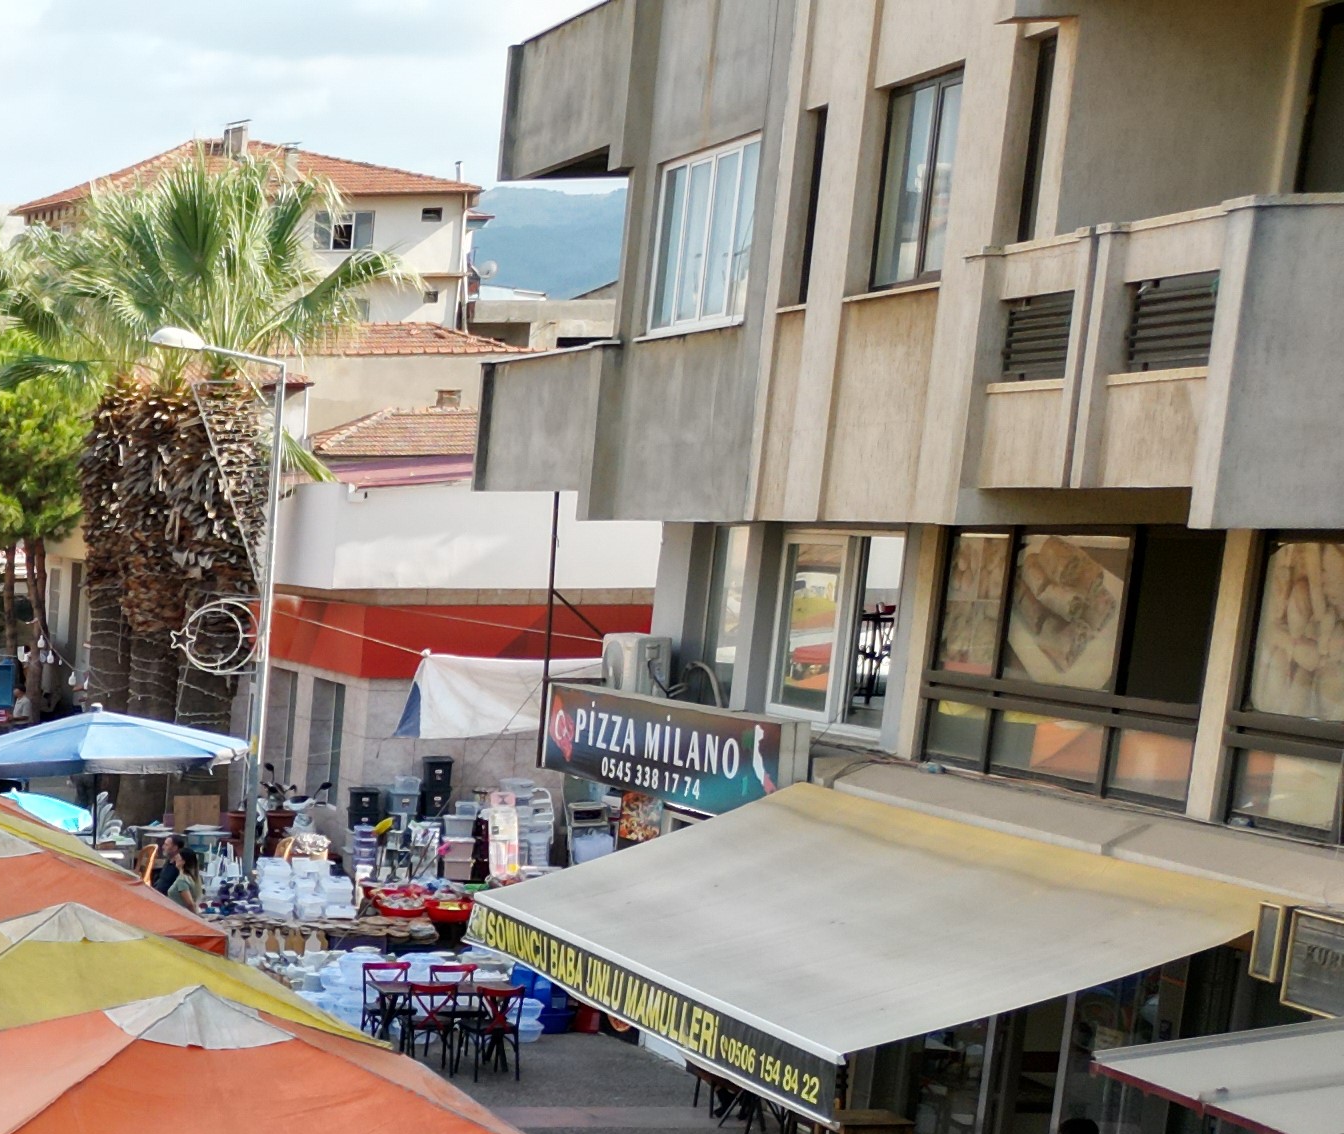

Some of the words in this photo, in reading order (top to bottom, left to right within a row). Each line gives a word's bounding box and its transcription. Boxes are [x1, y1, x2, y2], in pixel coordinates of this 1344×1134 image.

[574, 700, 636, 756] PİZZA
[644, 714, 740, 780] MİLANO
[601, 756, 632, 783] 0545
[634, 763, 659, 790] 338
[663, 771, 679, 794] 17
[683, 776, 701, 800] 74
[485, 911, 547, 972] SOMUNCU
[549, 943, 583, 993] BABA
[623, 974, 720, 1060] MAMULLERİ
[727, 1040, 756, 1074] 0506
[759, 1052, 781, 1086] 154
[782, 1063, 799, 1095] 84
[801, 1073, 821, 1106] 22
